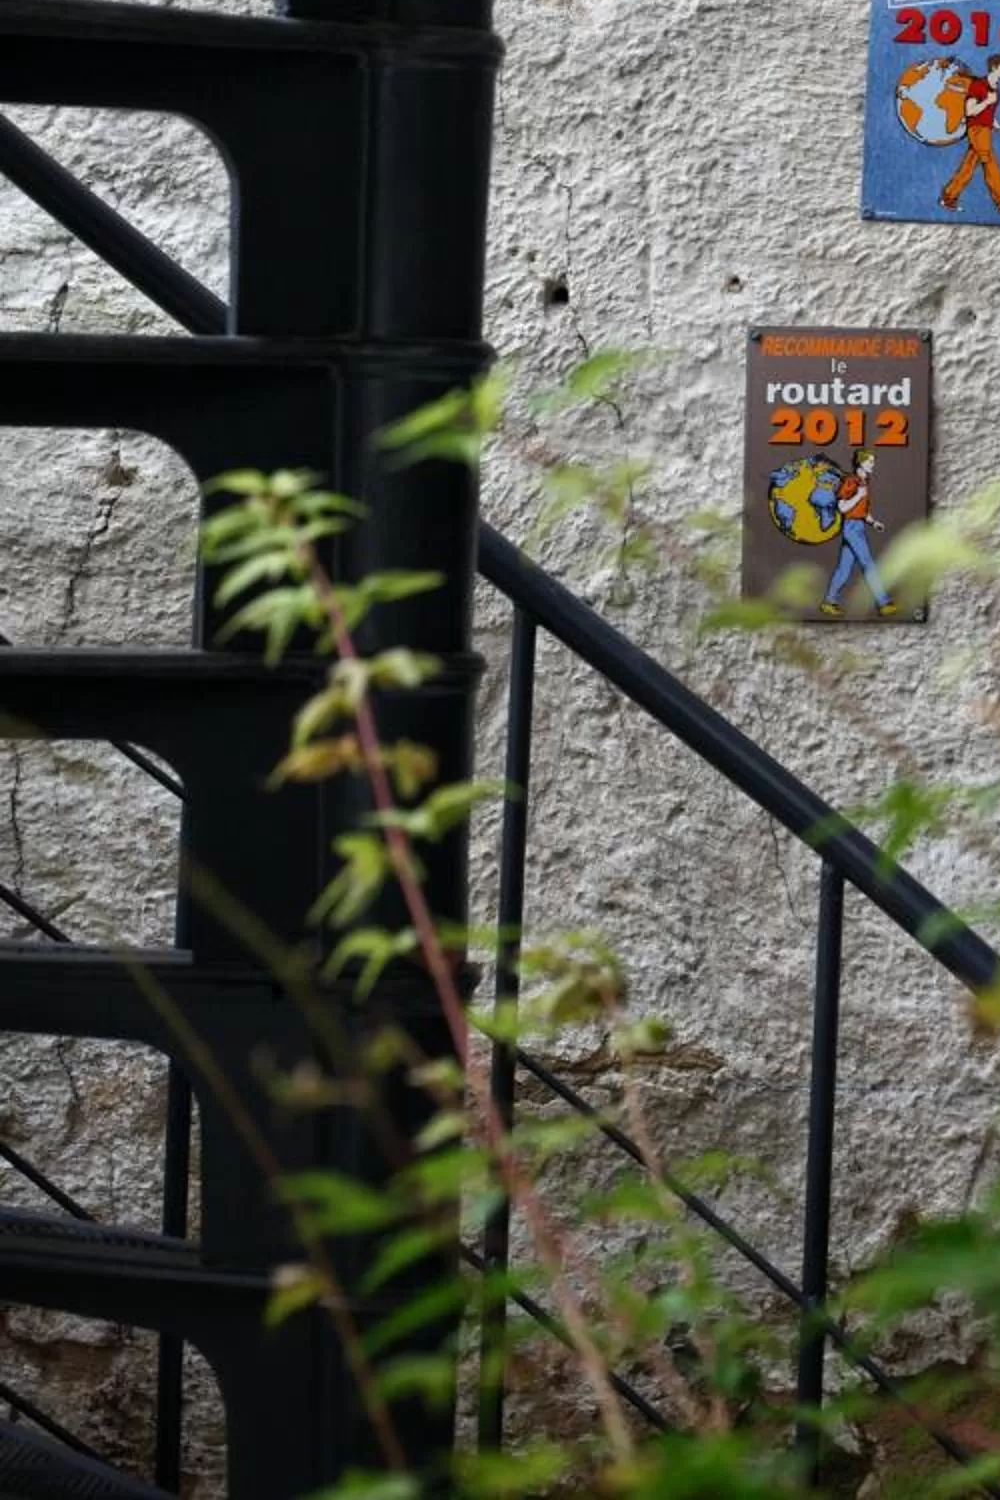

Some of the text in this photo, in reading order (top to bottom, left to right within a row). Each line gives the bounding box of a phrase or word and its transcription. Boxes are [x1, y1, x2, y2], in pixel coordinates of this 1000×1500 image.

[884, 338, 920, 357] PAR
[831, 358, 848, 373] le
[766, 377, 911, 406] routard
[768, 407, 909, 446] 2012
